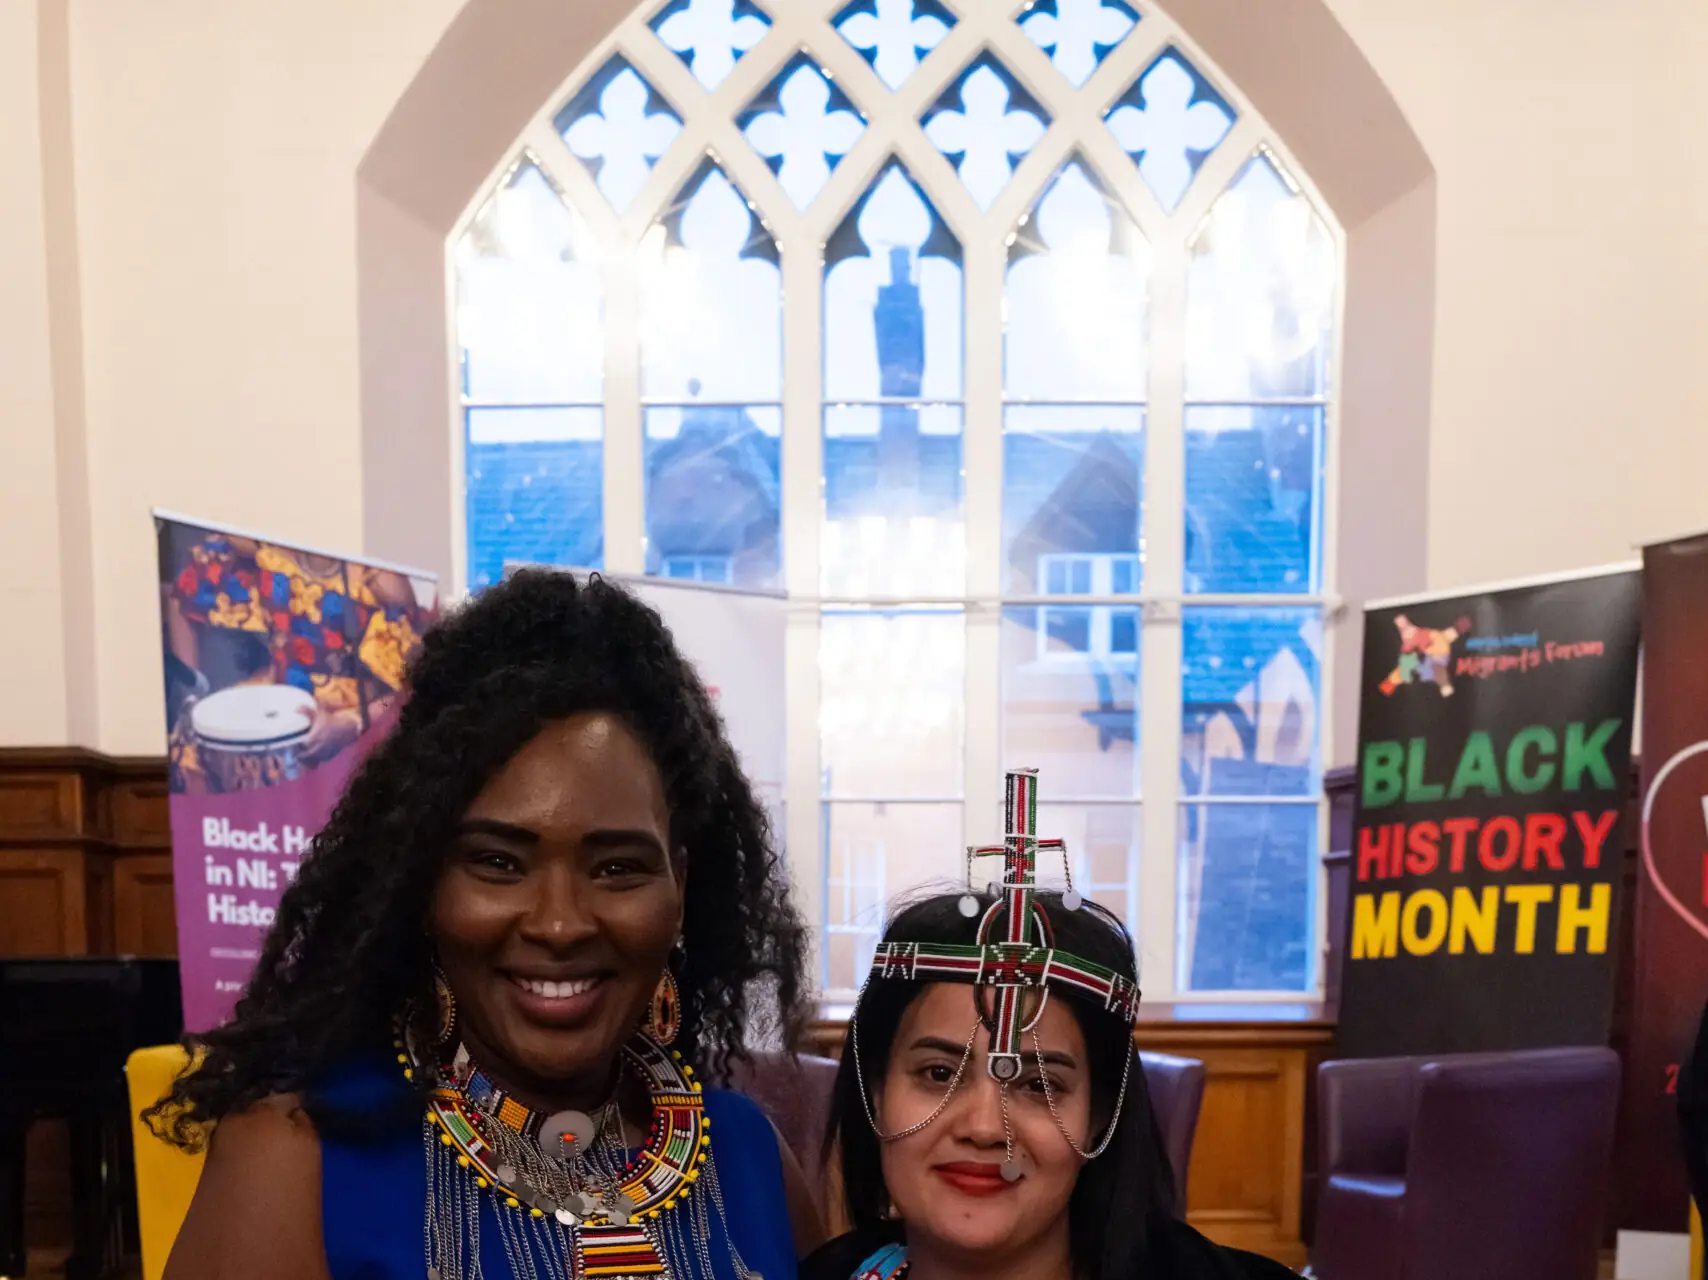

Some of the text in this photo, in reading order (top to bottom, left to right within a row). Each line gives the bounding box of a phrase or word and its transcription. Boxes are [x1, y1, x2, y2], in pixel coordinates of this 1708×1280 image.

[1362, 718, 1623, 809] BLACK
[202, 816, 280, 854] Black
[1357, 810, 1619, 882] HISTORY
[204, 854, 300, 890] in NI: T
[1351, 883, 1612, 960] MONTH
